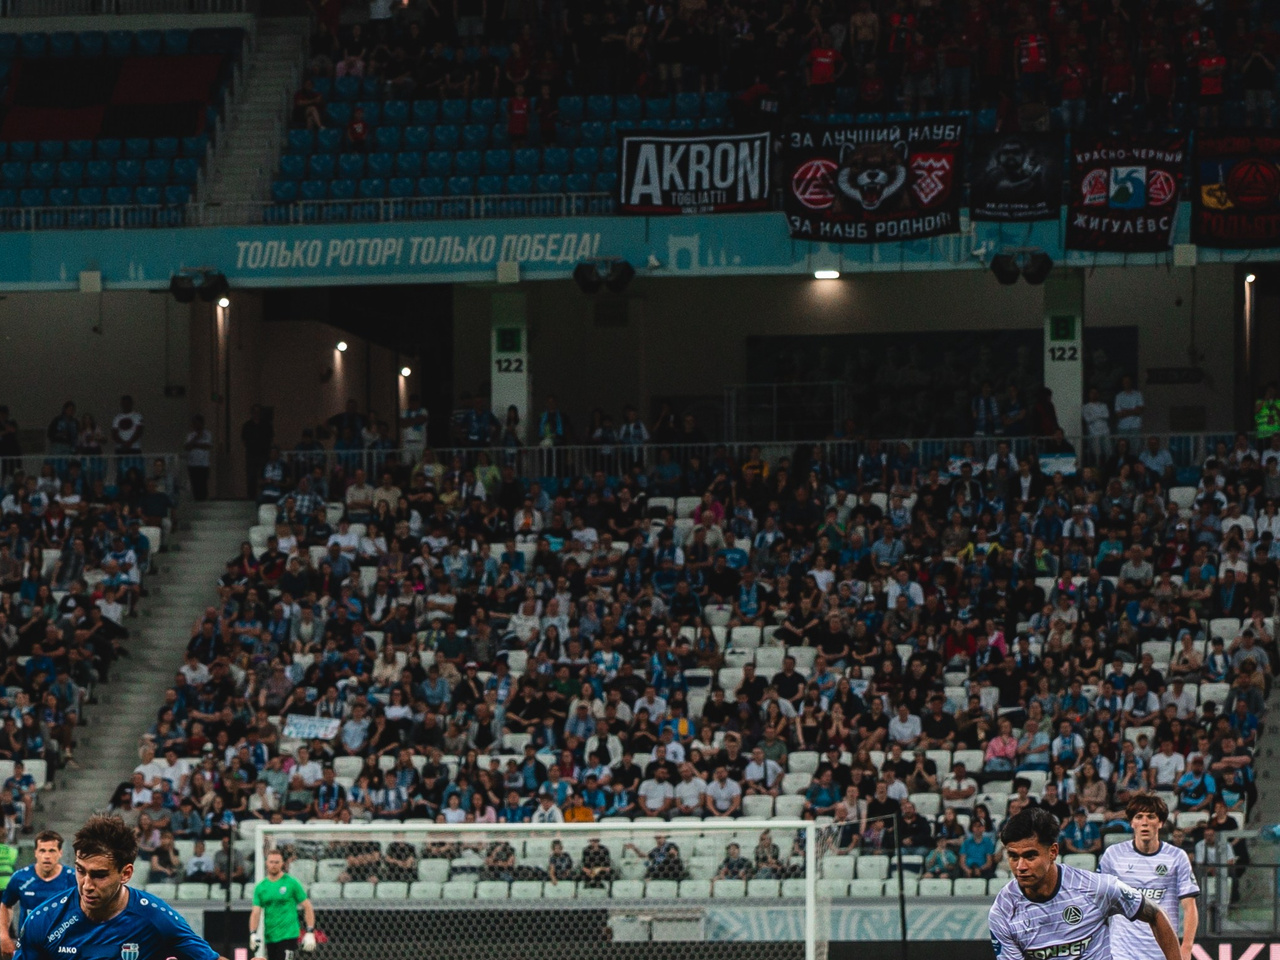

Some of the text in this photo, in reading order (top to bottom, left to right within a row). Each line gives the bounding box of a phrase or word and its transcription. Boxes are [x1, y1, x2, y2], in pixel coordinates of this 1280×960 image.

[790, 132, 814, 147] ЗА
[822, 125, 901, 147] ЛУЧШИЙ
[629, 140, 761, 206] AKRON
[670, 190, 727, 205] TOGLIATTI
[790, 215, 813, 234] ЗА
[820, 221, 868, 239] КЛУБ
[236, 232, 601, 269] ТОЛЬКО РОТОР! ТОЛЬКО ПОБЕДА!
[495, 358, 523, 372] 122
[1049, 347, 1078, 361] 122
[47, 915, 79, 942] legalbet
[58, 946, 78, 954] JAKO
